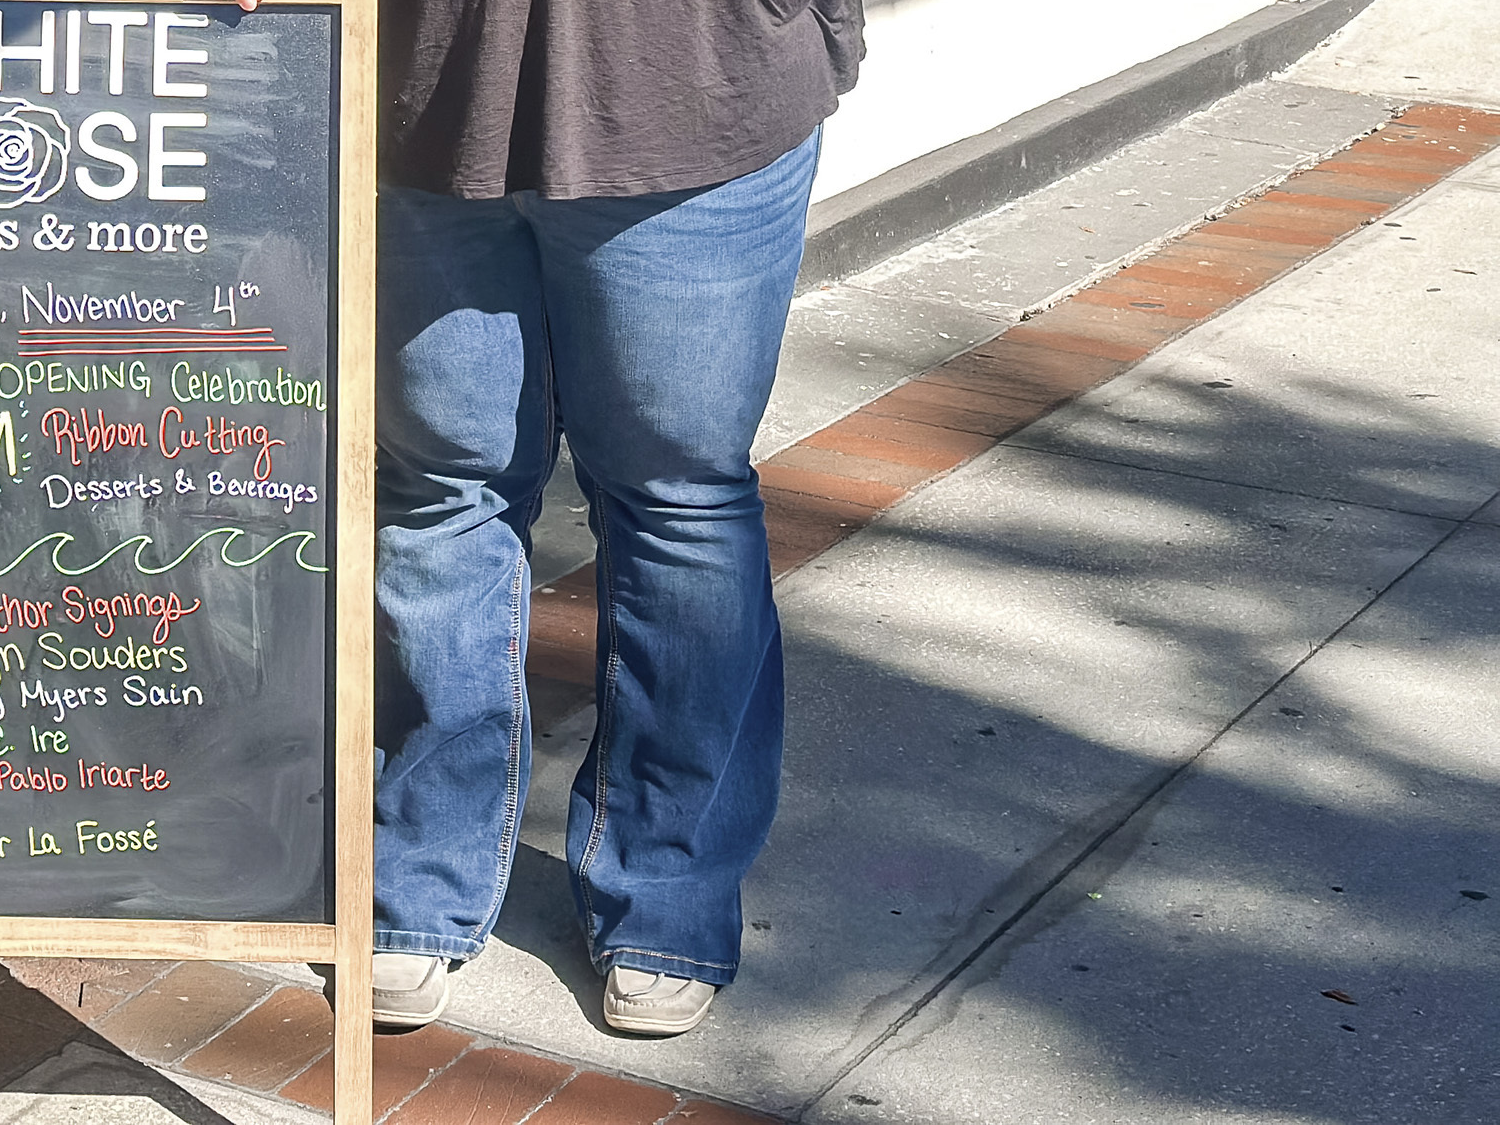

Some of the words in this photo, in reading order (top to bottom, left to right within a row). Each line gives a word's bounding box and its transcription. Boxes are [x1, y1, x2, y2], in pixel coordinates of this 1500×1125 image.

[31, 213, 75, 252] &
[85, 219, 209, 253] more
[20, 281, 185, 325] November
[170, 360, 327, 412] Celebration
[40, 407, 148, 465] Ribbon
[158, 405, 286, 479] Cutting
[40, 473, 164, 512] Desserts
[174, 469, 197, 494] &
[207, 471, 319, 514] Beverages
[62, 586, 202, 644] Signings
[39, 632, 189, 673] Souders
[19, 684, 109, 724] Myers
[123, 676, 204, 708] Sain
[31, 726, 70, 755] Ire
[78, 759, 170, 792] Iriarte
[29, 826, 61, 856] La
[77, 820, 159, 855] Fossé
